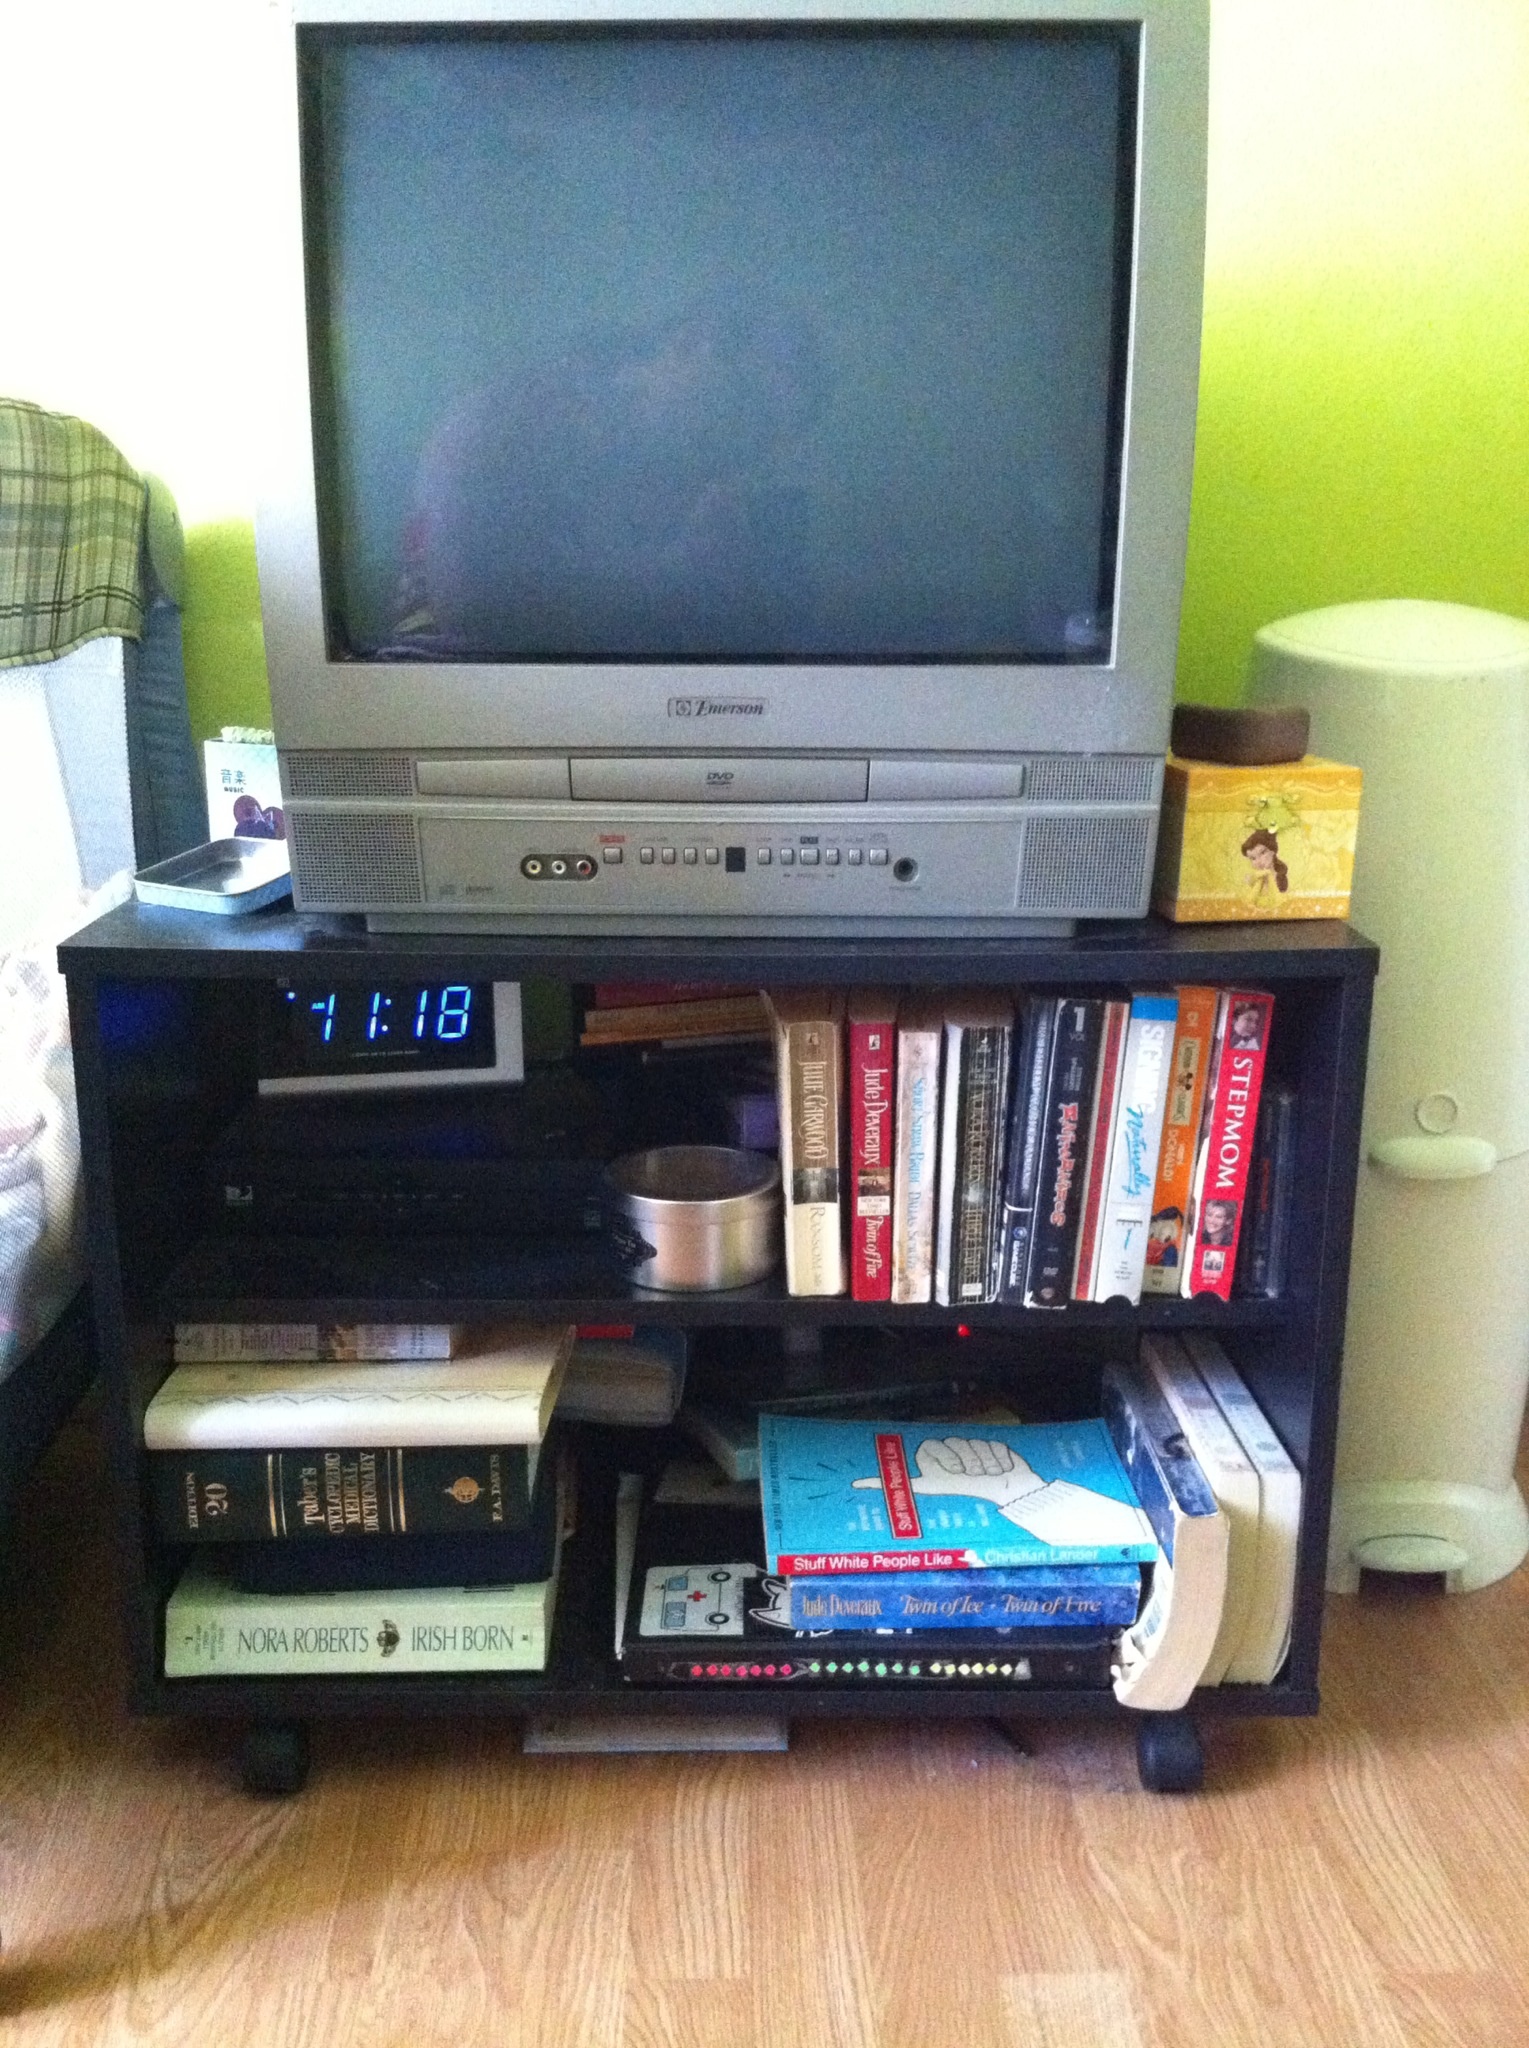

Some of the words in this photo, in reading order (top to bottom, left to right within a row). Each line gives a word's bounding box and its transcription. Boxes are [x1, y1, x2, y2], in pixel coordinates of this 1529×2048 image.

[695, 700, 764, 716] Emerson
[706, 772, 734, 781] DVD
[797, 1060, 827, 1094] JULIE
[861, 1065, 889, 1101] Jude
[1135, 1025, 1166, 1114] SIGNING
[799, 1094, 828, 1160] GARWOOD
[859, 1100, 888, 1165] Deveraux
[1216, 1057, 1253, 1189] STEPMOM
[1119, 1104, 1150, 1197] Naturally
[865, 1216, 884, 1243] Twin
[863, 1244, 882, 1257] of
[866, 1257, 882, 1278] Fire
[888, 1460, 904, 1489] People
[185, 1472, 199, 1529] EDITION
[204, 1482, 228, 1516] 20
[299, 1467, 325, 1526] Taber's
[324, 1452, 345, 1534] CYCLOPEDIC
[343, 1463, 360, 1525] MEDICAL
[360, 1452, 379, 1532] DICTIONARY
[892, 1489, 909, 1513] White
[895, 1511, 913, 1531] Stuff
[794, 1556, 827, 1571] Stuff
[829, 1555, 870, 1570] White
[873, 1554, 920, 1571] People
[924, 1552, 953, 1567] Like
[985, 1547, 1046, 1564] Christian
[802, 1594, 828, 1617] Jude
[830, 1594, 883, 1617] Deveraux
[901, 1594, 938, 1615] Twin
[940, 1595, 960, 1617] of
[960, 1595, 983, 1614] Ice
[1001, 1593, 1041, 1614] Twin
[1042, 1593, 1061, 1615] of
[1062, 1594, 1102, 1614] Fire
[238, 1628, 288, 1653] NORA
[294, 1626, 369, 1653] ROBERTS
[412, 1626, 456, 1651] IRISH
[462, 1625, 514, 1651] BORN
